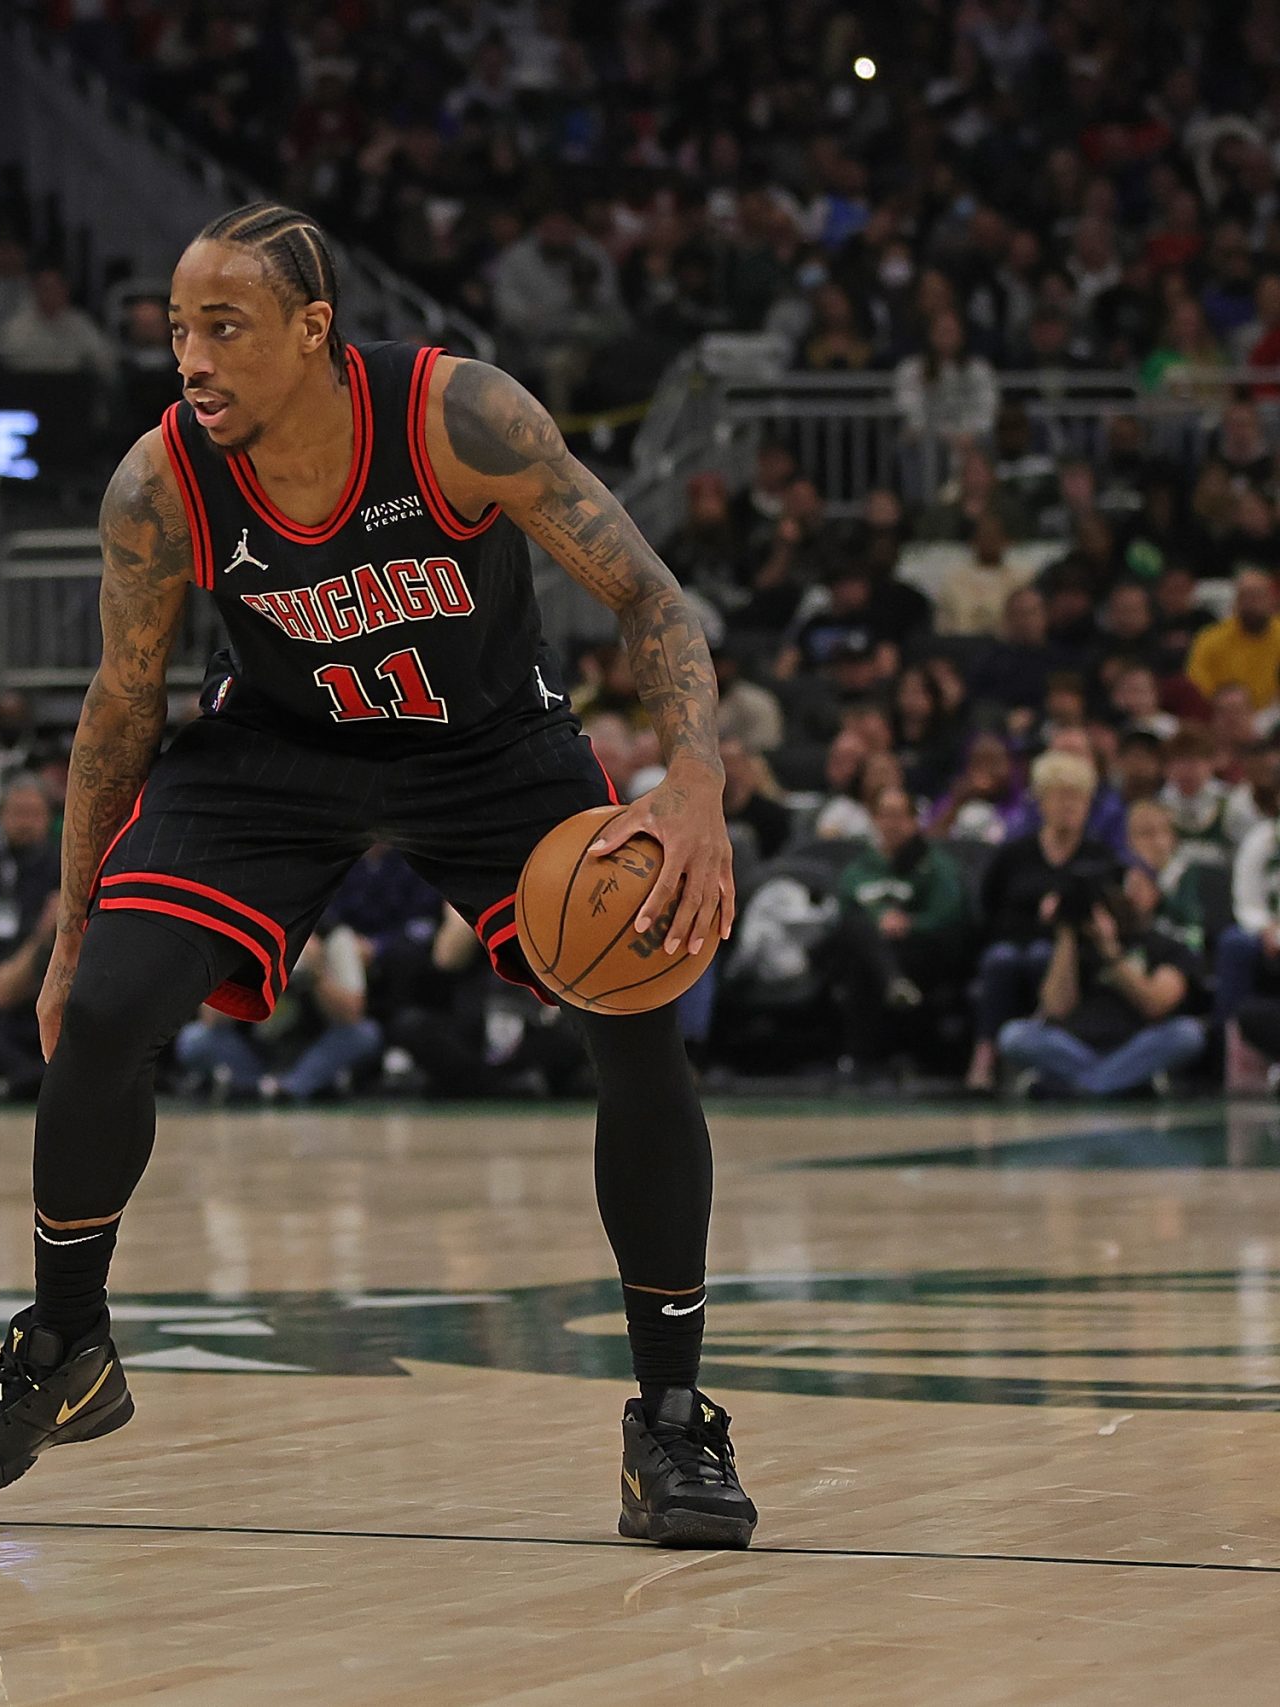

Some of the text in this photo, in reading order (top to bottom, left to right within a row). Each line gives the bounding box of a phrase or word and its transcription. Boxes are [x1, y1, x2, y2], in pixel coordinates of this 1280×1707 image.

[360, 495, 420, 522] ZENNI
[365, 509, 423, 532] EYEWEAR
[313, 647, 448, 723] 11
